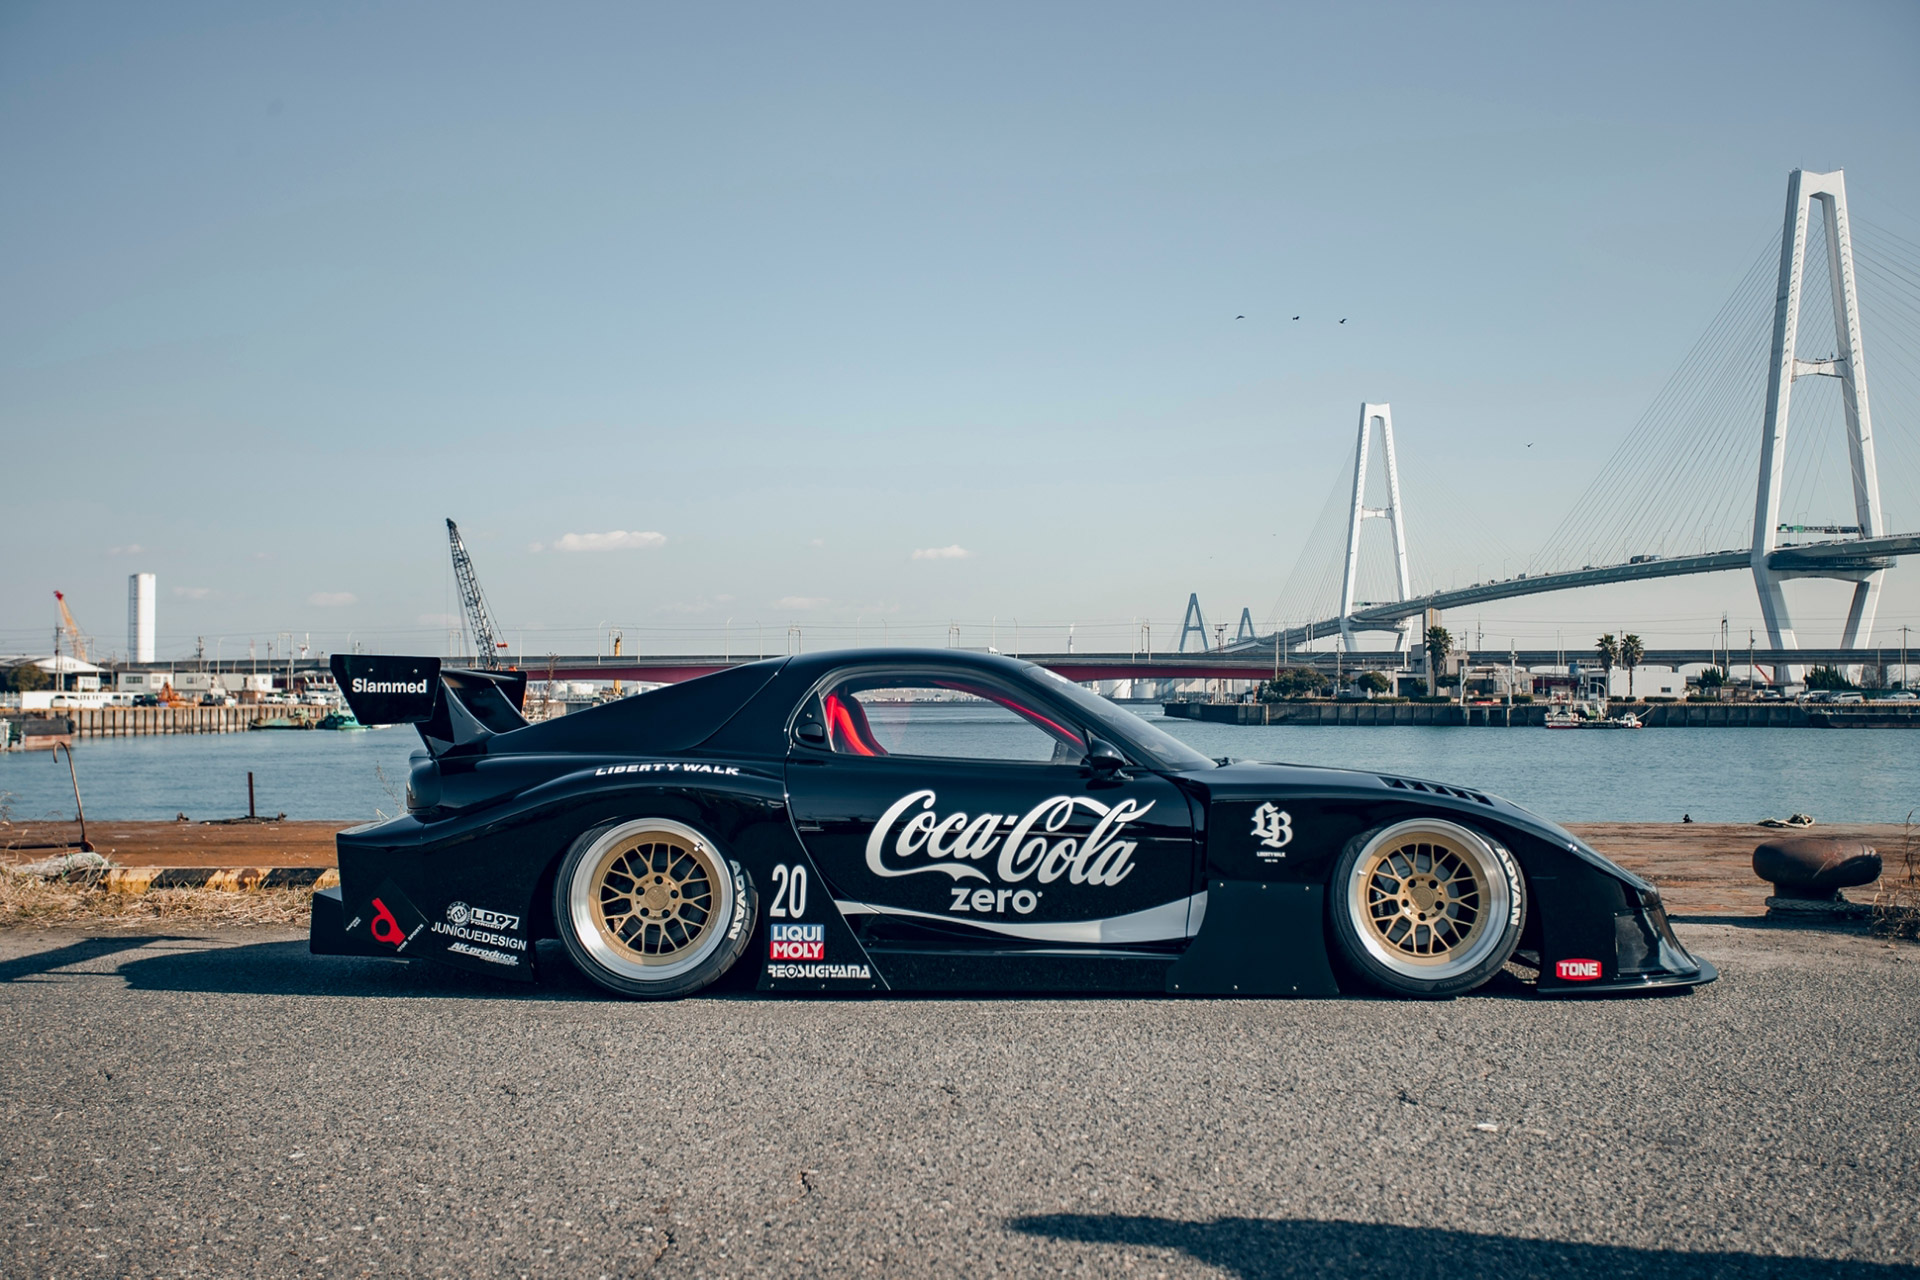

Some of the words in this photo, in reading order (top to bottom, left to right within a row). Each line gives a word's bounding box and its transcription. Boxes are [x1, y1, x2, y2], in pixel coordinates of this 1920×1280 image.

[352, 678, 427, 693] Slammed
[596, 763, 679, 776] LIBERTY
[683, 763, 739, 775] WALK
[866, 789, 1155, 886] Coca-Cola
[769, 864, 807, 918] 20
[1495, 848, 1521, 926] ADVAN
[729, 860, 746, 941] ADVAN
[950, 887, 1038, 914] zero
[471, 908, 520, 930] LD97
[431, 921, 527, 951] JUNIQUEDESIGN
[773, 926, 822, 942] LIQUI
[449, 942, 518, 962] AK-produce
[773, 943, 824, 958] MOLY
[1559, 962, 1598, 977] TONE
